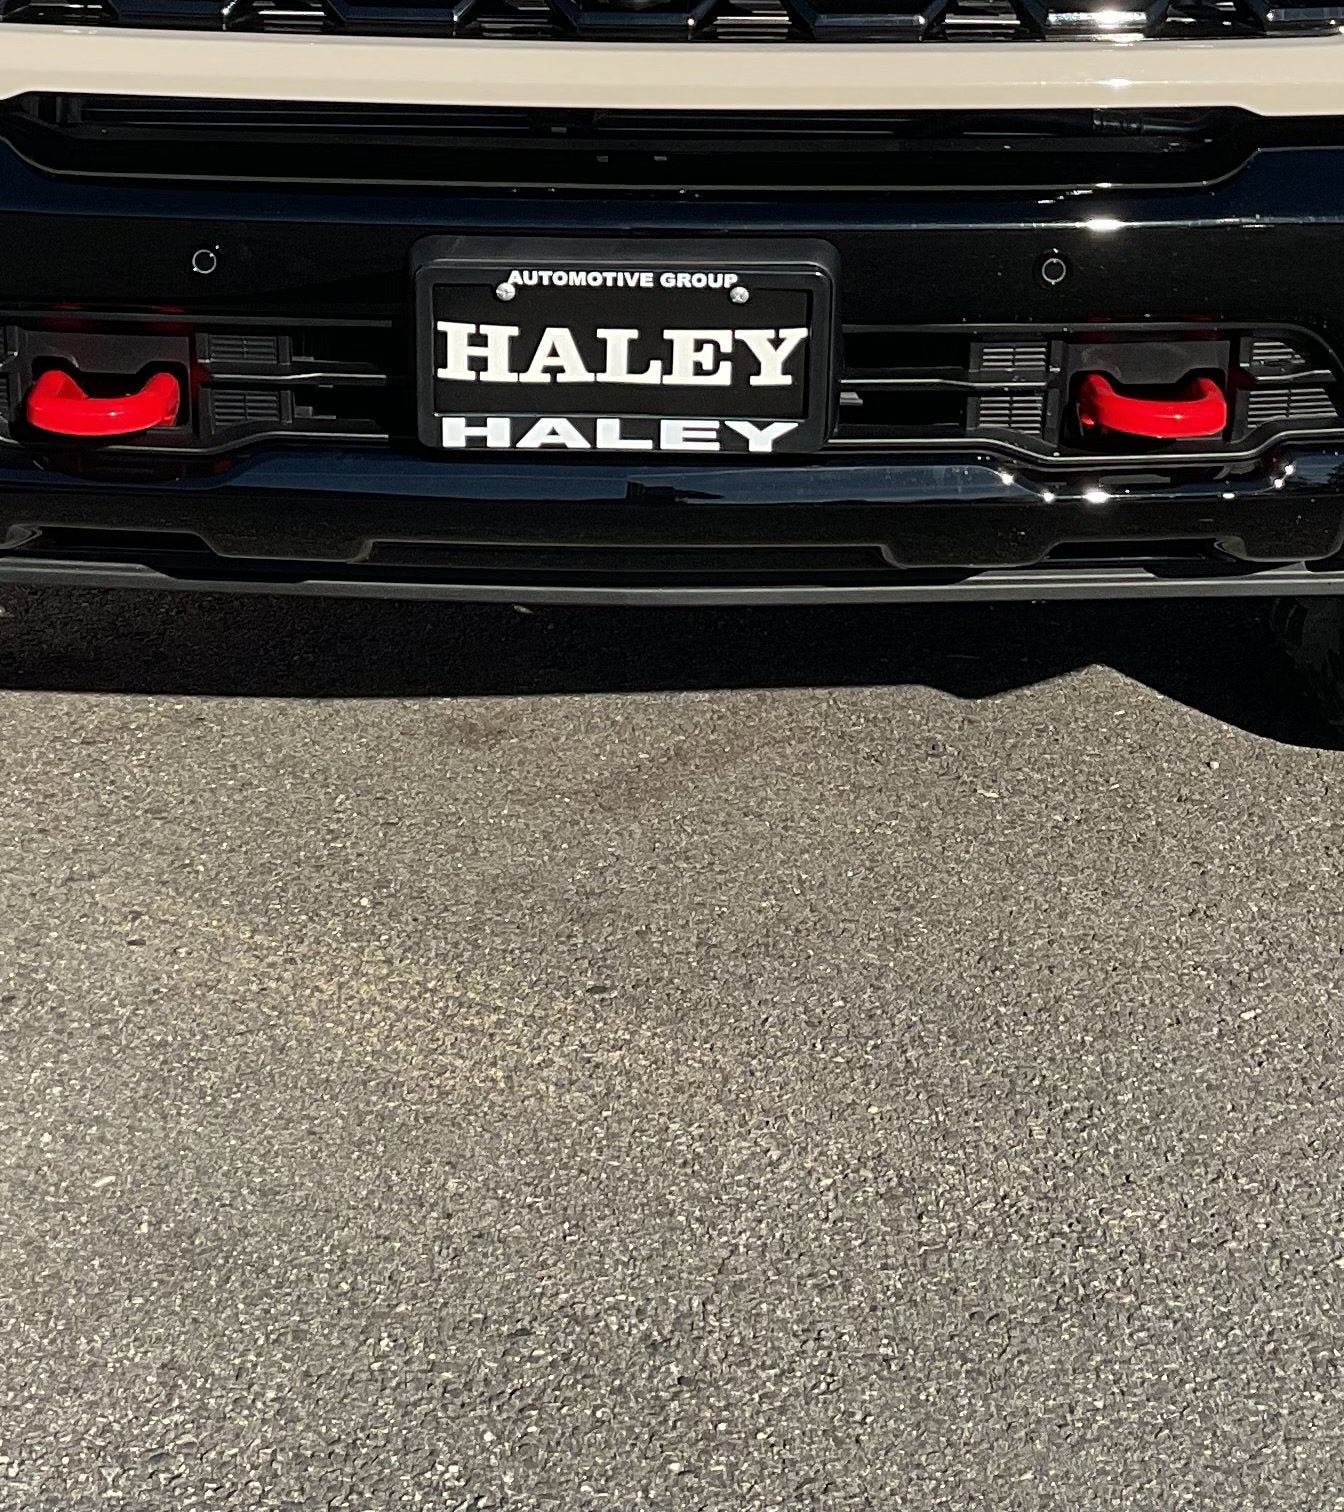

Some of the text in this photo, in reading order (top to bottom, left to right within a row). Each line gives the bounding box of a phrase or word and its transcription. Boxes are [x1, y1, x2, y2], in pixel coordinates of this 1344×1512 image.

[508, 270, 739, 289] AUTOMOTIVE GROUP
[436, 320, 809, 387] HALEY
[441, 417, 799, 453] HALEY
